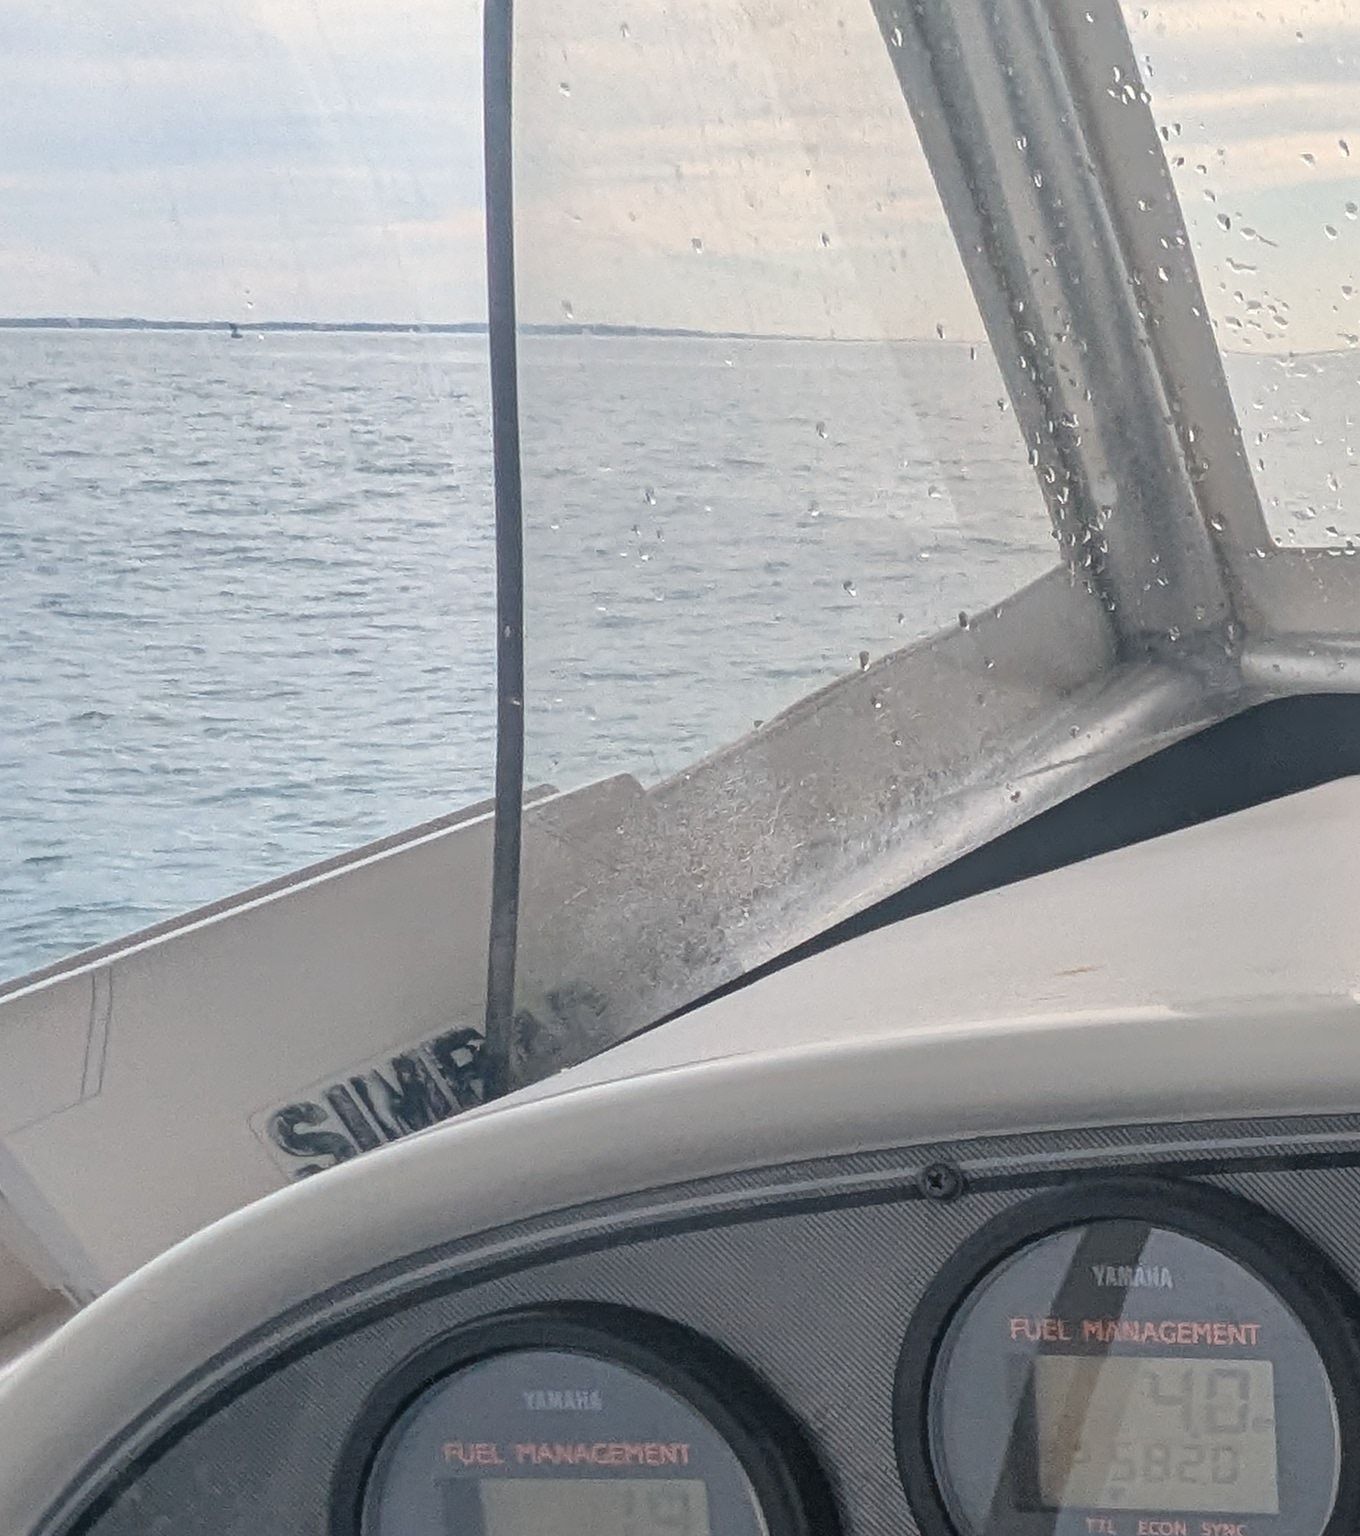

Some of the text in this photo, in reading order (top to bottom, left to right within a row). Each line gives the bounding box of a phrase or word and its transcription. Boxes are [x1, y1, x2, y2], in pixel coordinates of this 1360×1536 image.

[1093, 1264, 1173, 1289] YAMAHA
[1010, 1317, 1262, 1347] FUEL MANAGEMENT
[522, 1389, 603, 1411] YAMAHA
[441, 1442, 691, 1467] FUEL MANAGEMENT
[1085, 1519, 1118, 1536] TTL
